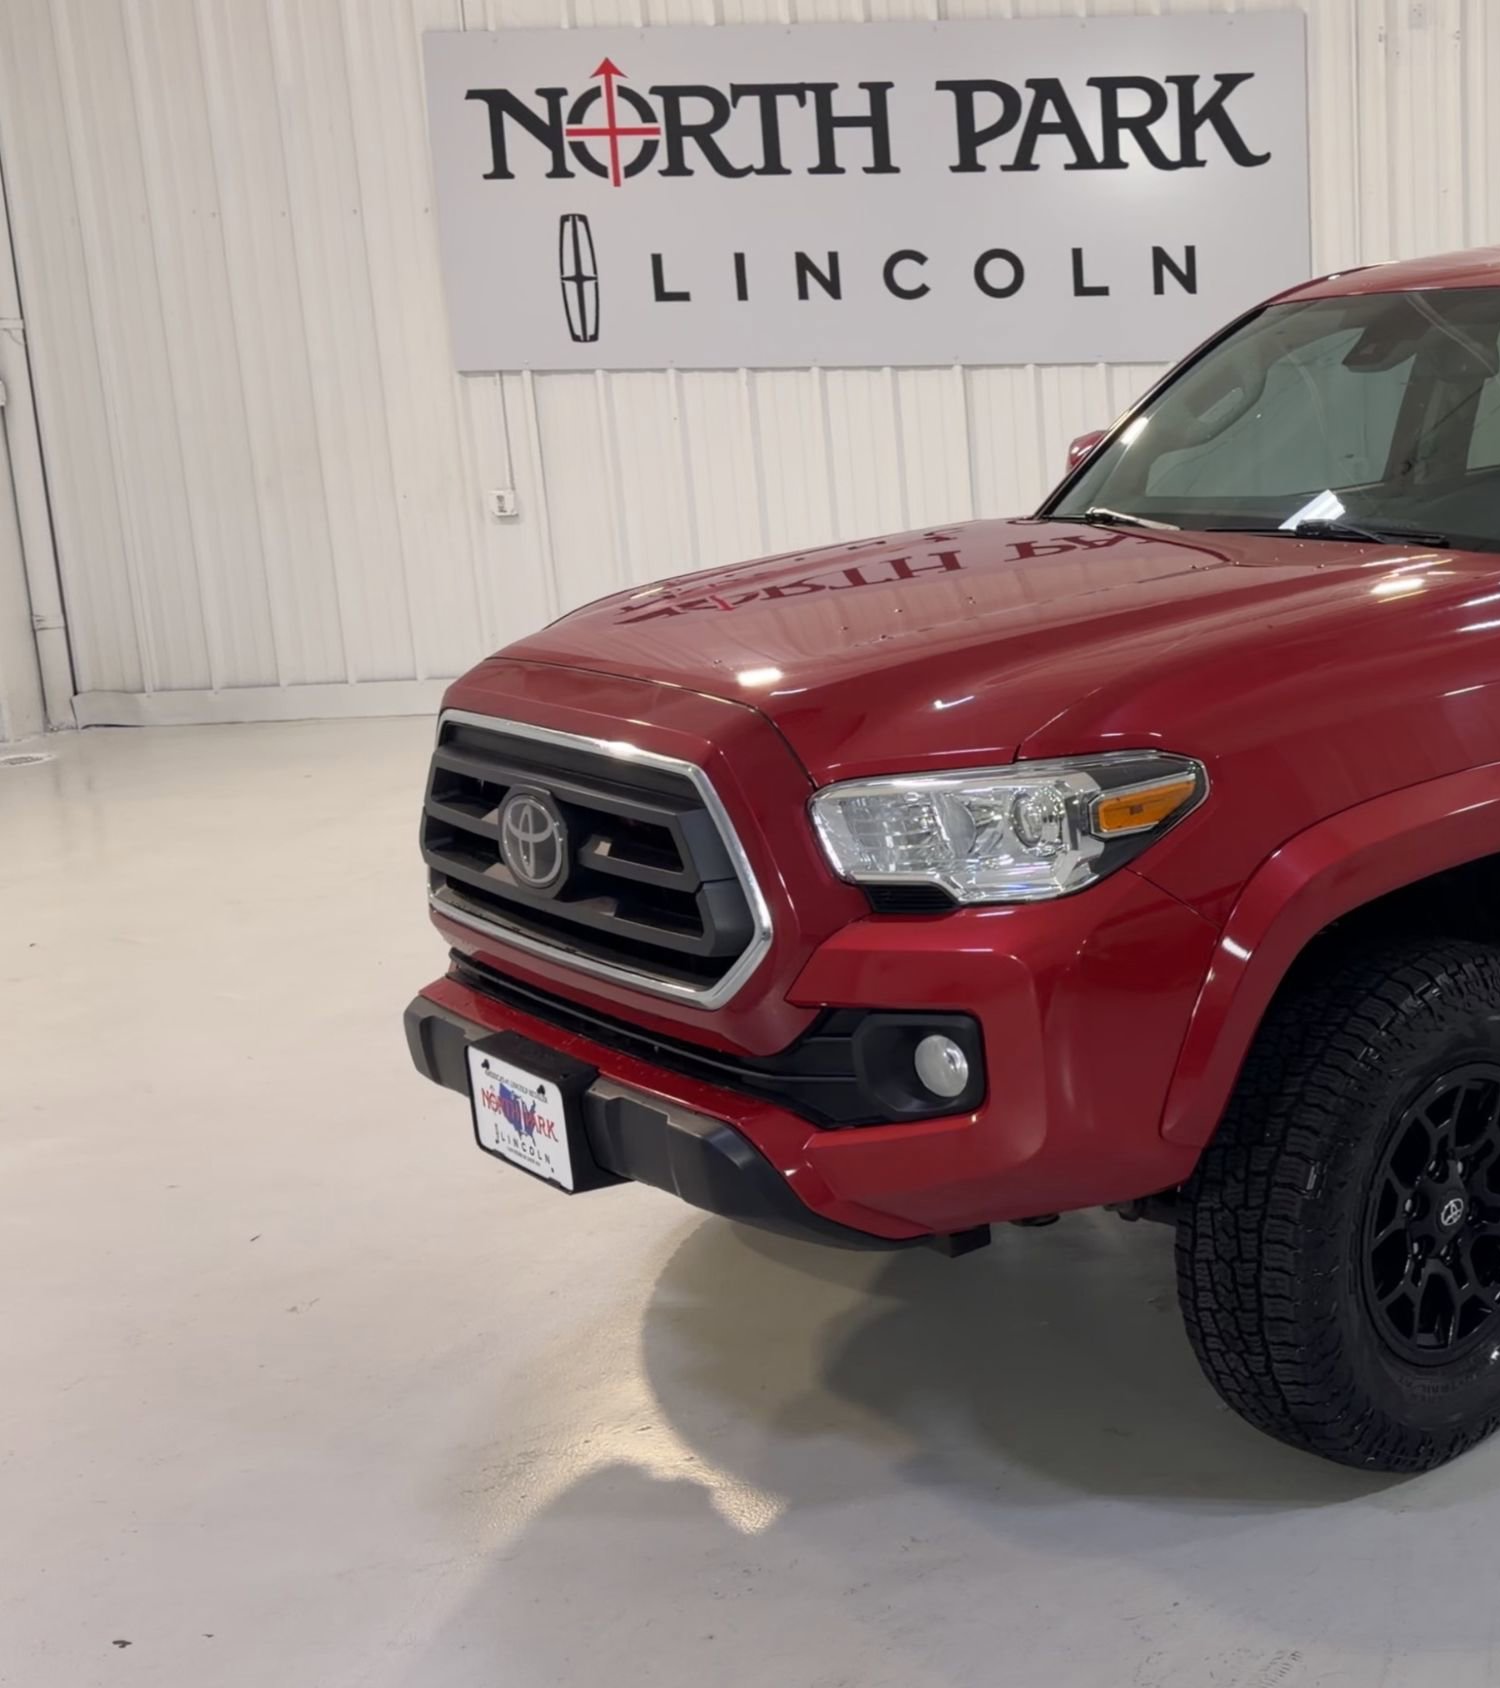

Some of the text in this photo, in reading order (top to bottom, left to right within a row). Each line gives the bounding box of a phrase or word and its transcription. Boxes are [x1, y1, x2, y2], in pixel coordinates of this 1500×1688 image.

[465, 73, 1270, 184] NORTH PARK
[652, 246, 1197, 302] LINCOLN
[522, 1102, 559, 1143] PARK
[501, 1132, 551, 1164] LINCOLN
